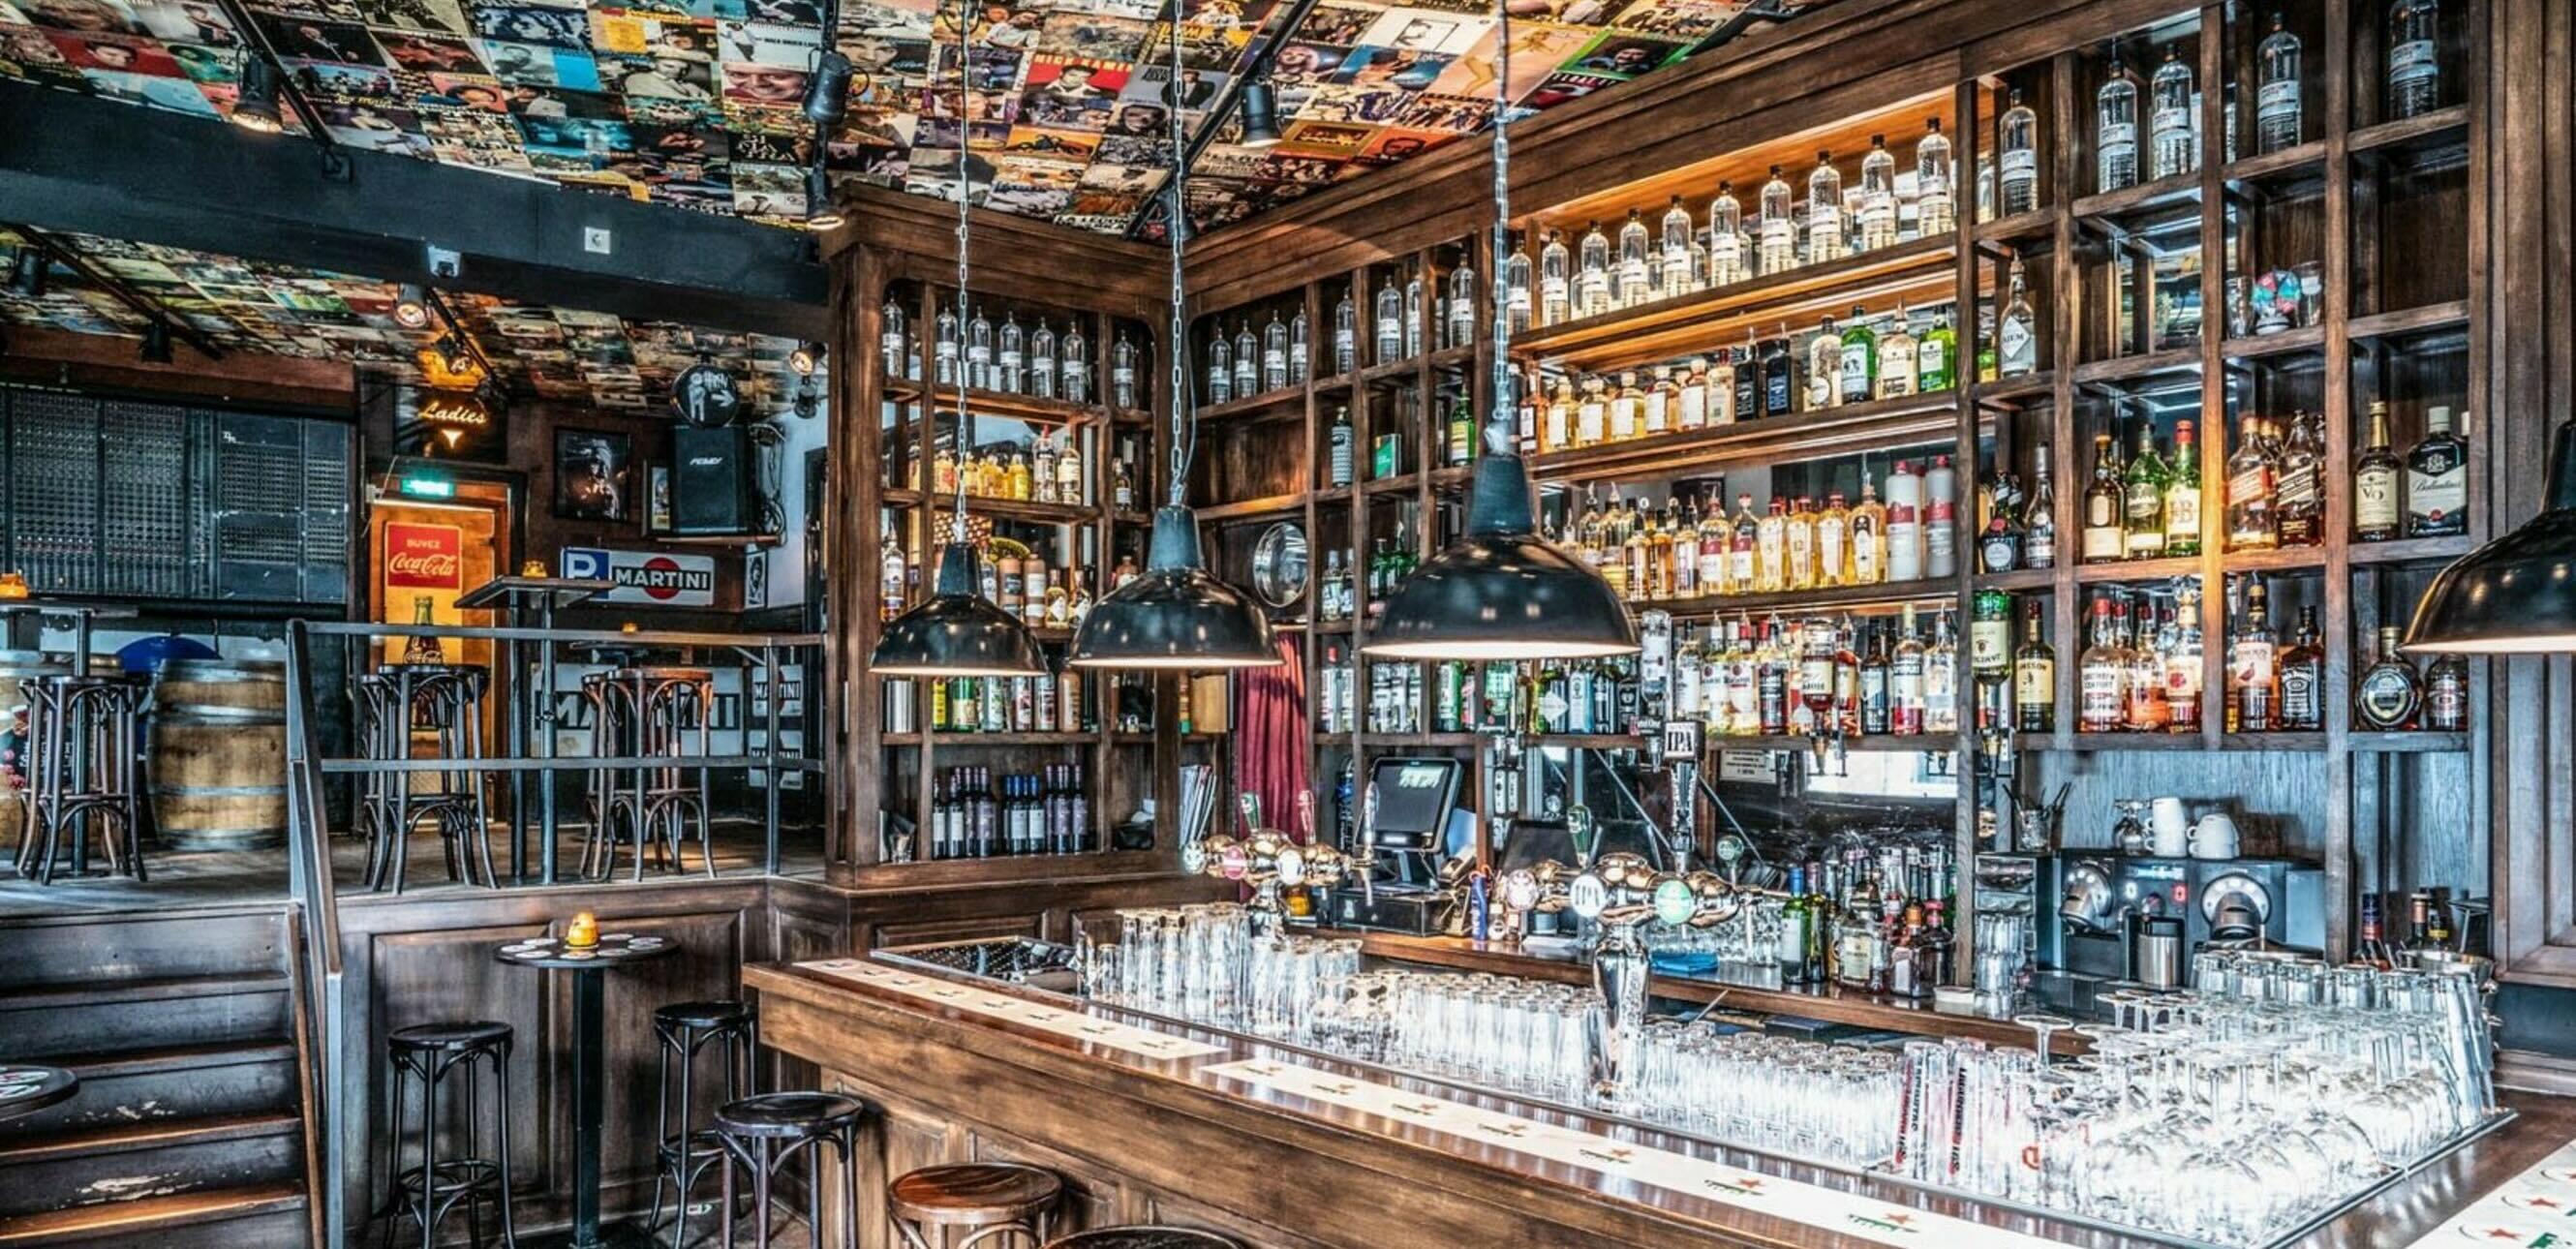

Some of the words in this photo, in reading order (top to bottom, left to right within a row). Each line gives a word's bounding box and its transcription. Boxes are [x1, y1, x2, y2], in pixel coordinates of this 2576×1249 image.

[417, 400, 488, 425] Ladies
[406, 538, 442, 549] BUVEZ
[567, 553, 598, 580] P
[615, 568, 708, 589] MARTINI
[754, 683, 800, 698] MATINI
[1667, 731, 1693, 752] IPA
